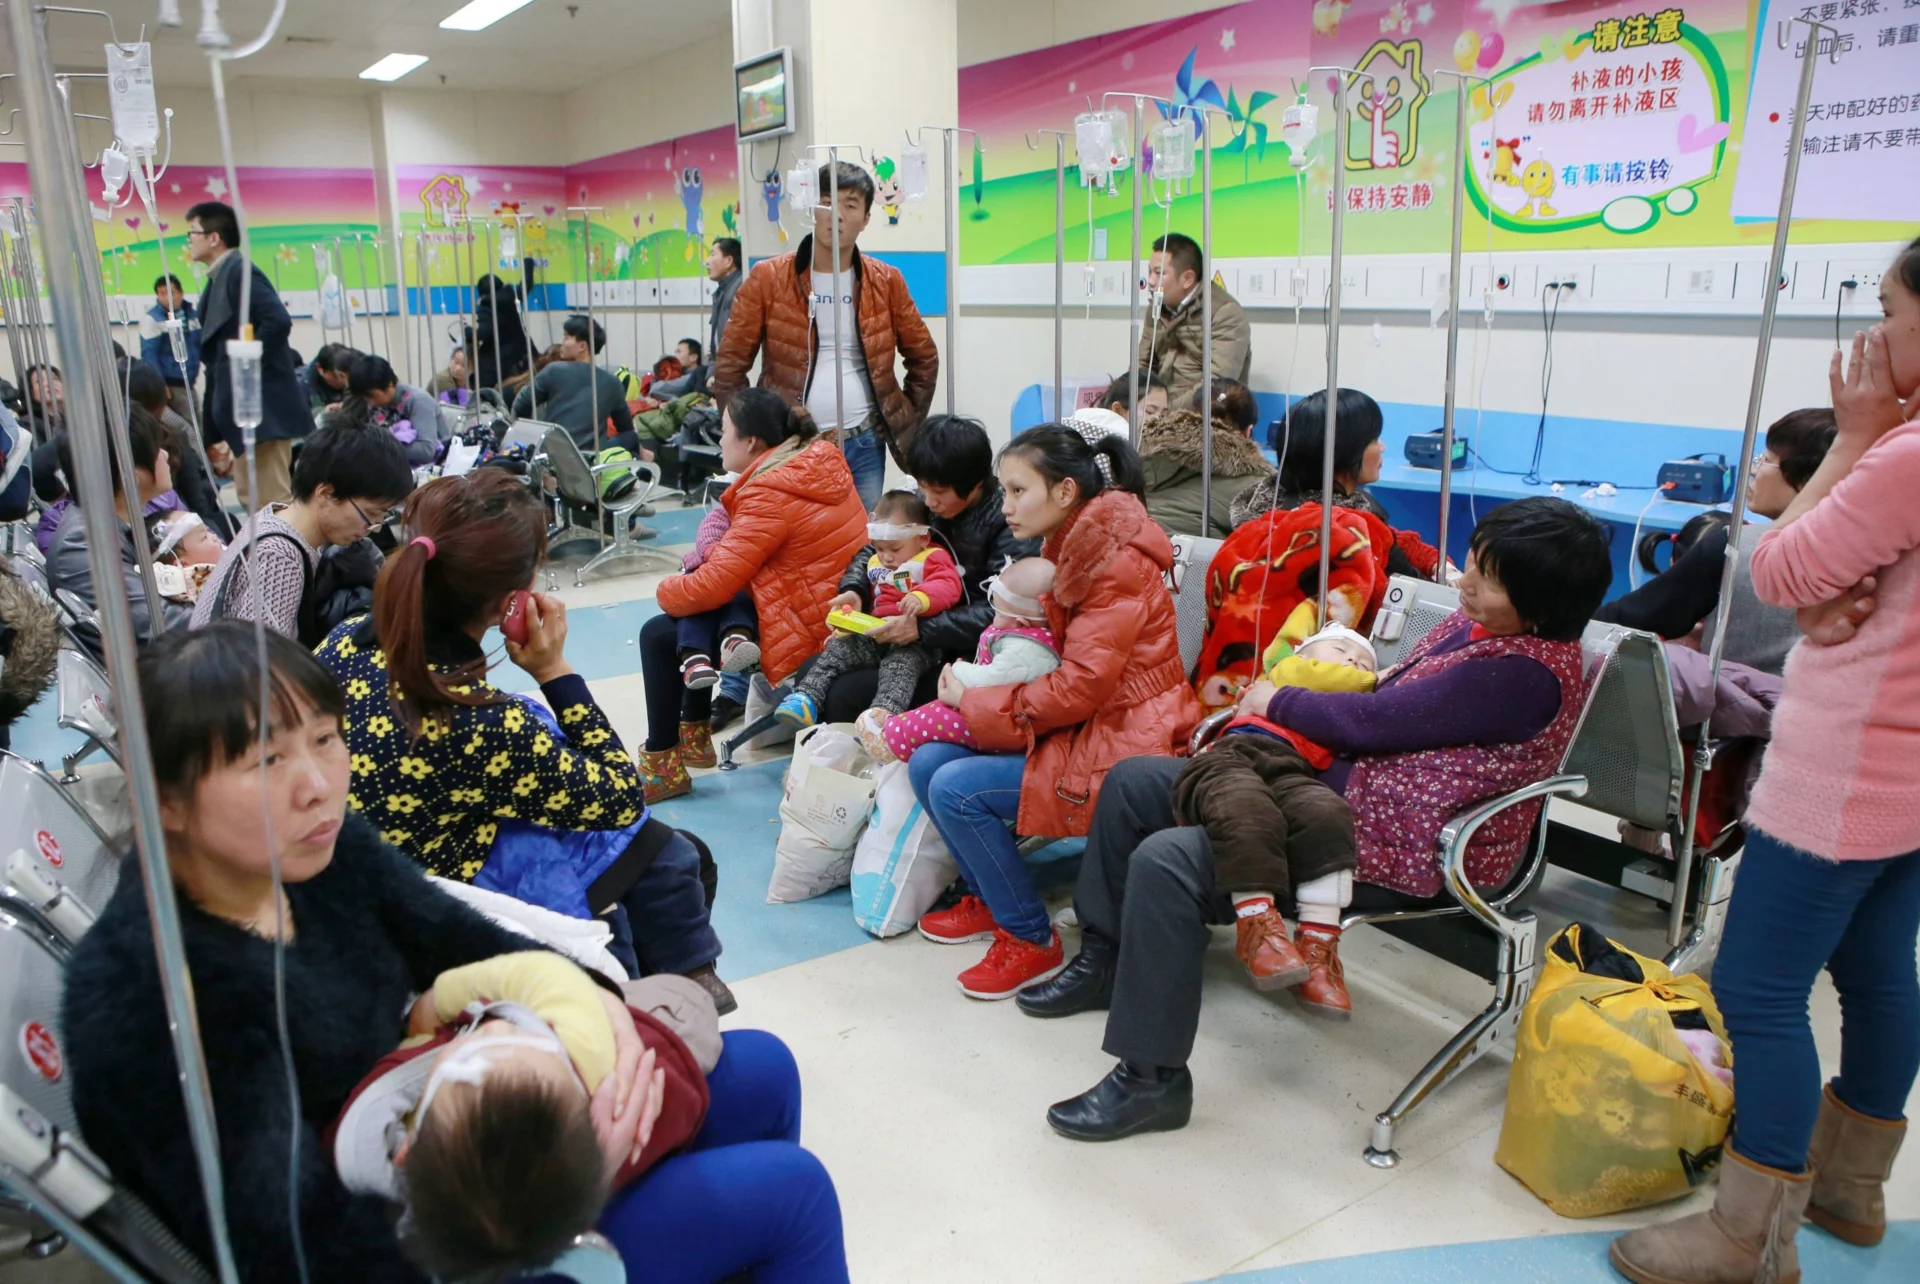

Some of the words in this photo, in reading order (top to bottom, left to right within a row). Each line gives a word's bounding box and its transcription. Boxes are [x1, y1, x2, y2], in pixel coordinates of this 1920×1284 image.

[1593, 8, 1684, 53] 请注意
[1571, 57, 1684, 92] 补液的小孩
[1528, 87, 1680, 124] 请勿离开补液区
[1784, 127, 1920, 156] 输注请不要带
[1561, 158, 1671, 187] 有事请按铃
